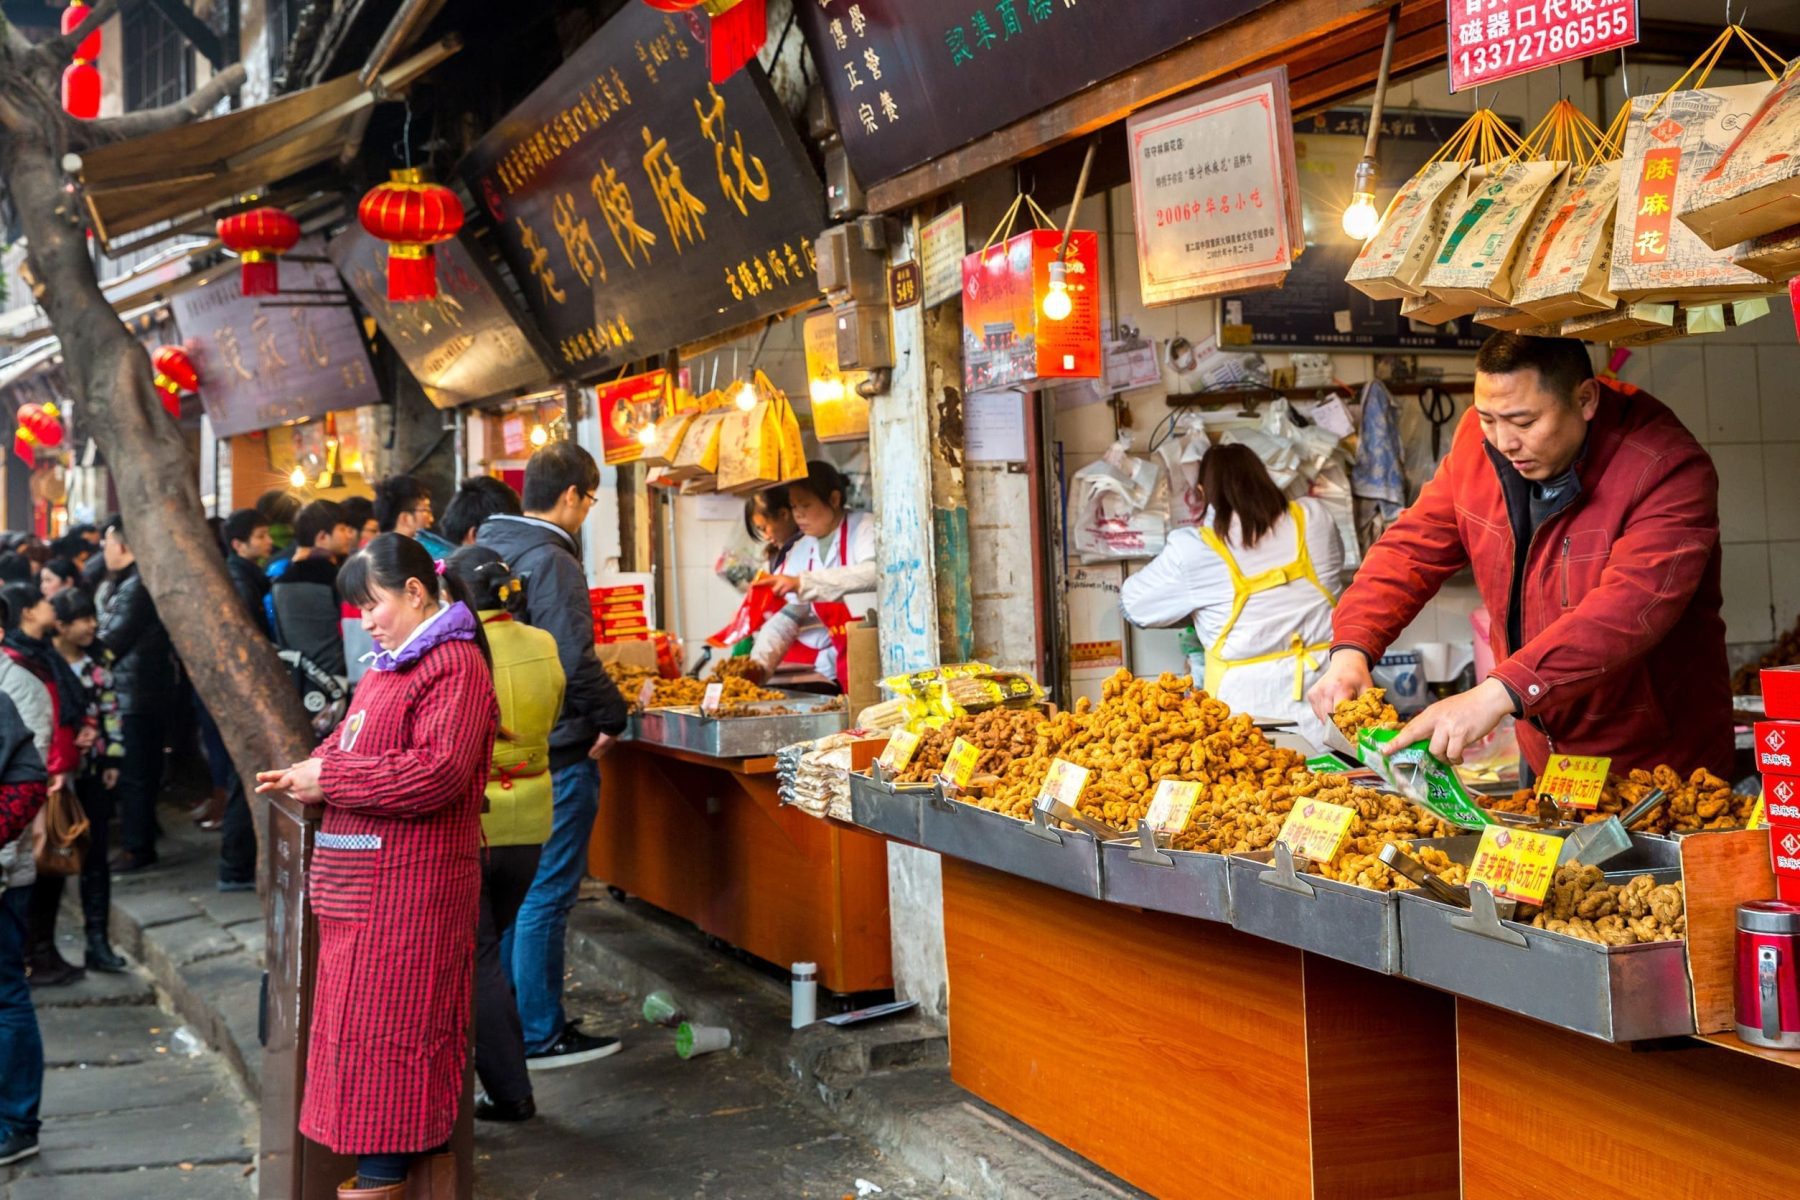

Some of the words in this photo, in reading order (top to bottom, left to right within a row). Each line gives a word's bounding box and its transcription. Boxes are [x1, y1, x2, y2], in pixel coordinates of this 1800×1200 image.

[1460, 7, 1628, 77] 13372786555
[1634, 157, 1676, 257] 陈麻花
[1473, 852, 1551, 892] 黑芝麻味15元/斤
